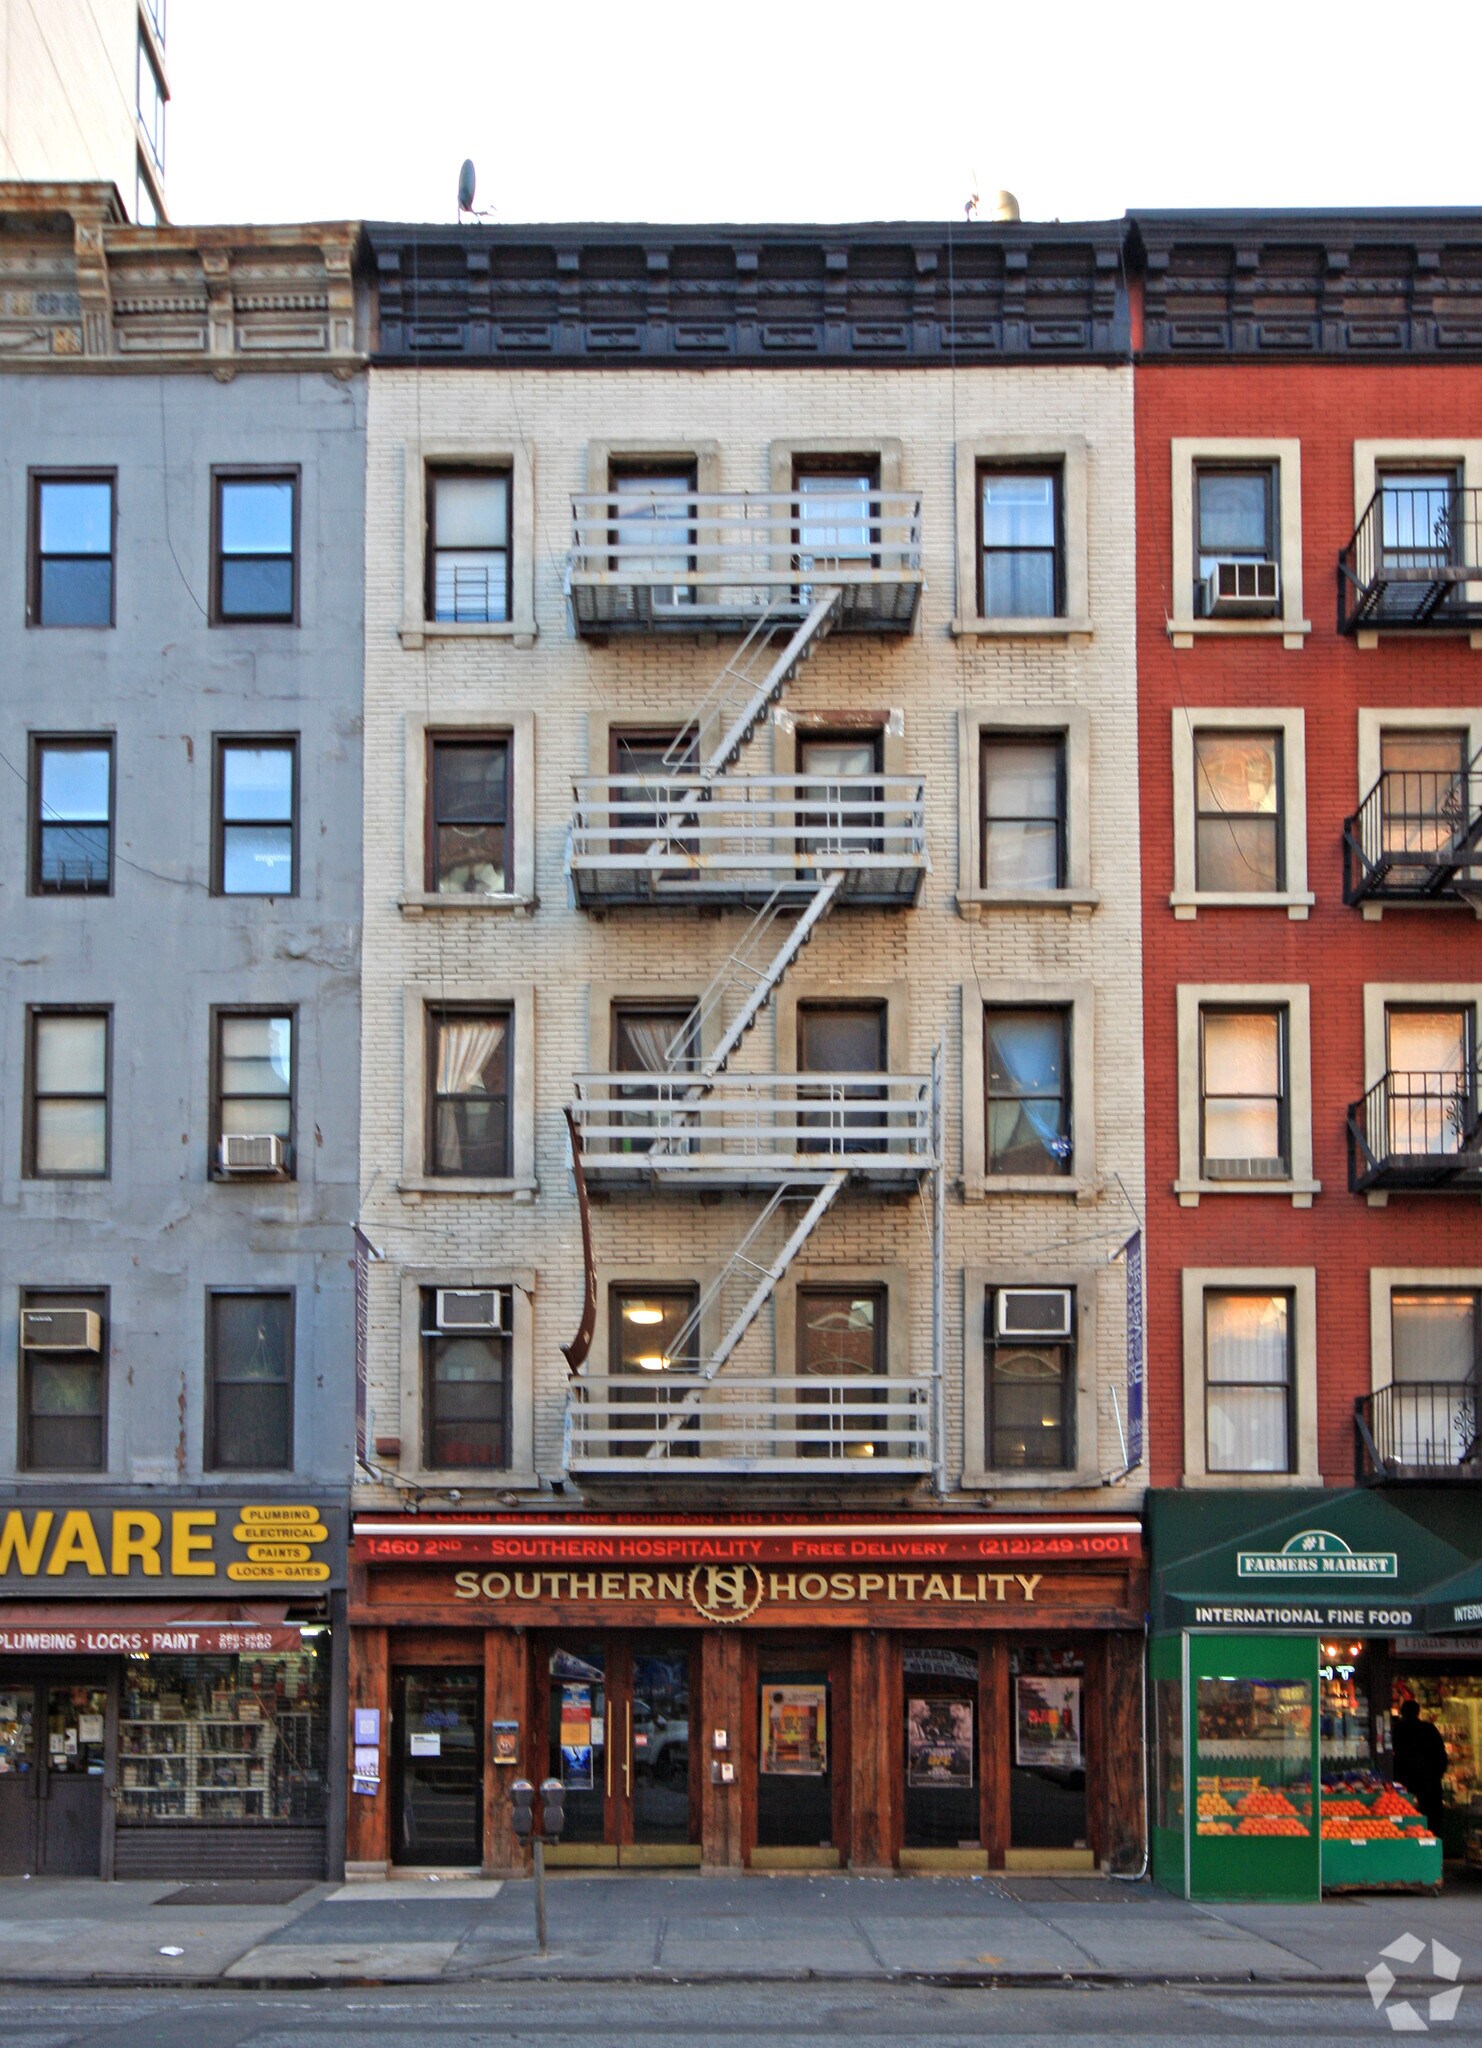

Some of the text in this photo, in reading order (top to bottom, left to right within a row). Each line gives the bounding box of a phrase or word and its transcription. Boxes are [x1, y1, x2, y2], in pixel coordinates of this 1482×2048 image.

[250, 1511, 310, 1519] PLUMBING
[245, 1528, 317, 1538] ELECTRICAL
[368, 1538, 420, 1555] 1460
[491, 1540, 613, 1556] SOUTHERN
[619, 1540, 763, 1557] HOSPITALITY
[978, 1536, 1129, 1555] (212)249-1001
[1301, 1535, 1326, 1551] #1
[258, 1548, 301, 1558] PAINTS
[236, 1567, 274, 1576] LOCKS
[285, 1567, 321, 1576] GATES
[1245, 1558, 1388, 1572] FARMERS MARKET
[454, 1571, 685, 1601] SOUTHERN
[769, 1573, 1043, 1602] HOSPITALITY
[1195, 1607, 1413, 1625] INTERNATIONAL FINE FOOD
[87, 1633, 142, 1649] LOCKS
[152, 1633, 199, 1649] PAINT
